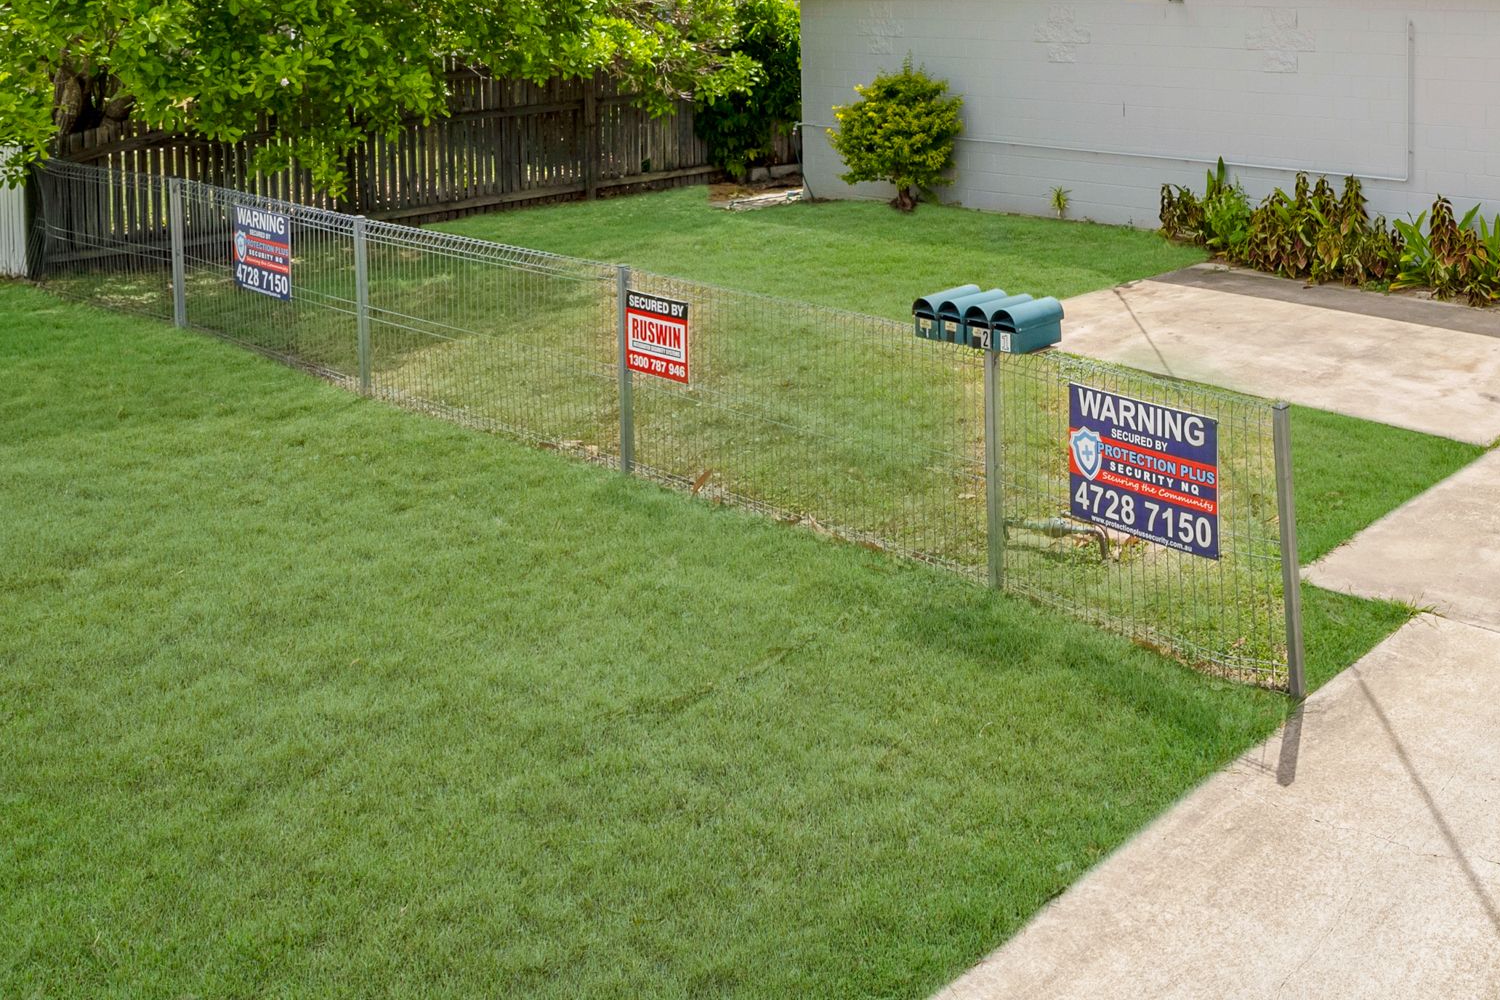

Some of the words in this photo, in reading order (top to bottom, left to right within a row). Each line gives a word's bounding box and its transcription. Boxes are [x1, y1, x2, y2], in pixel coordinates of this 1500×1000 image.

[236, 206, 285, 235] WARNING
[236, 263, 260, 287] 4728
[262, 270, 289, 295] 7150
[629, 294, 669, 315] SECURED
[671, 304, 684, 317] BY
[632, 317, 681, 349] RUSWIN
[982, 330, 989, 347] 2
[629, 353, 649, 369] 1300
[651, 358, 666, 373] 787
[668, 363, 685, 378] 946
[1078, 388, 1205, 447] WARNING
[1111, 428, 1153, 448] SECURED
[1155, 440, 1168, 452] BY
[1097, 440, 1176, 475] PROTECTION
[1180, 464, 1215, 485] PLUS
[1109, 461, 1174, 488] SECURITY
[1181, 481, 1200, 496] NQ
[1102, 471, 1139, 490] Securing
[1141, 484, 1157, 494] the
[1158, 489, 1214, 512] Community
[1075, 481, 1136, 525] 4728
[1144, 501, 1212, 548] 7150
[1090, 515, 1193, 552] www.protectionplussecurity.com.au
